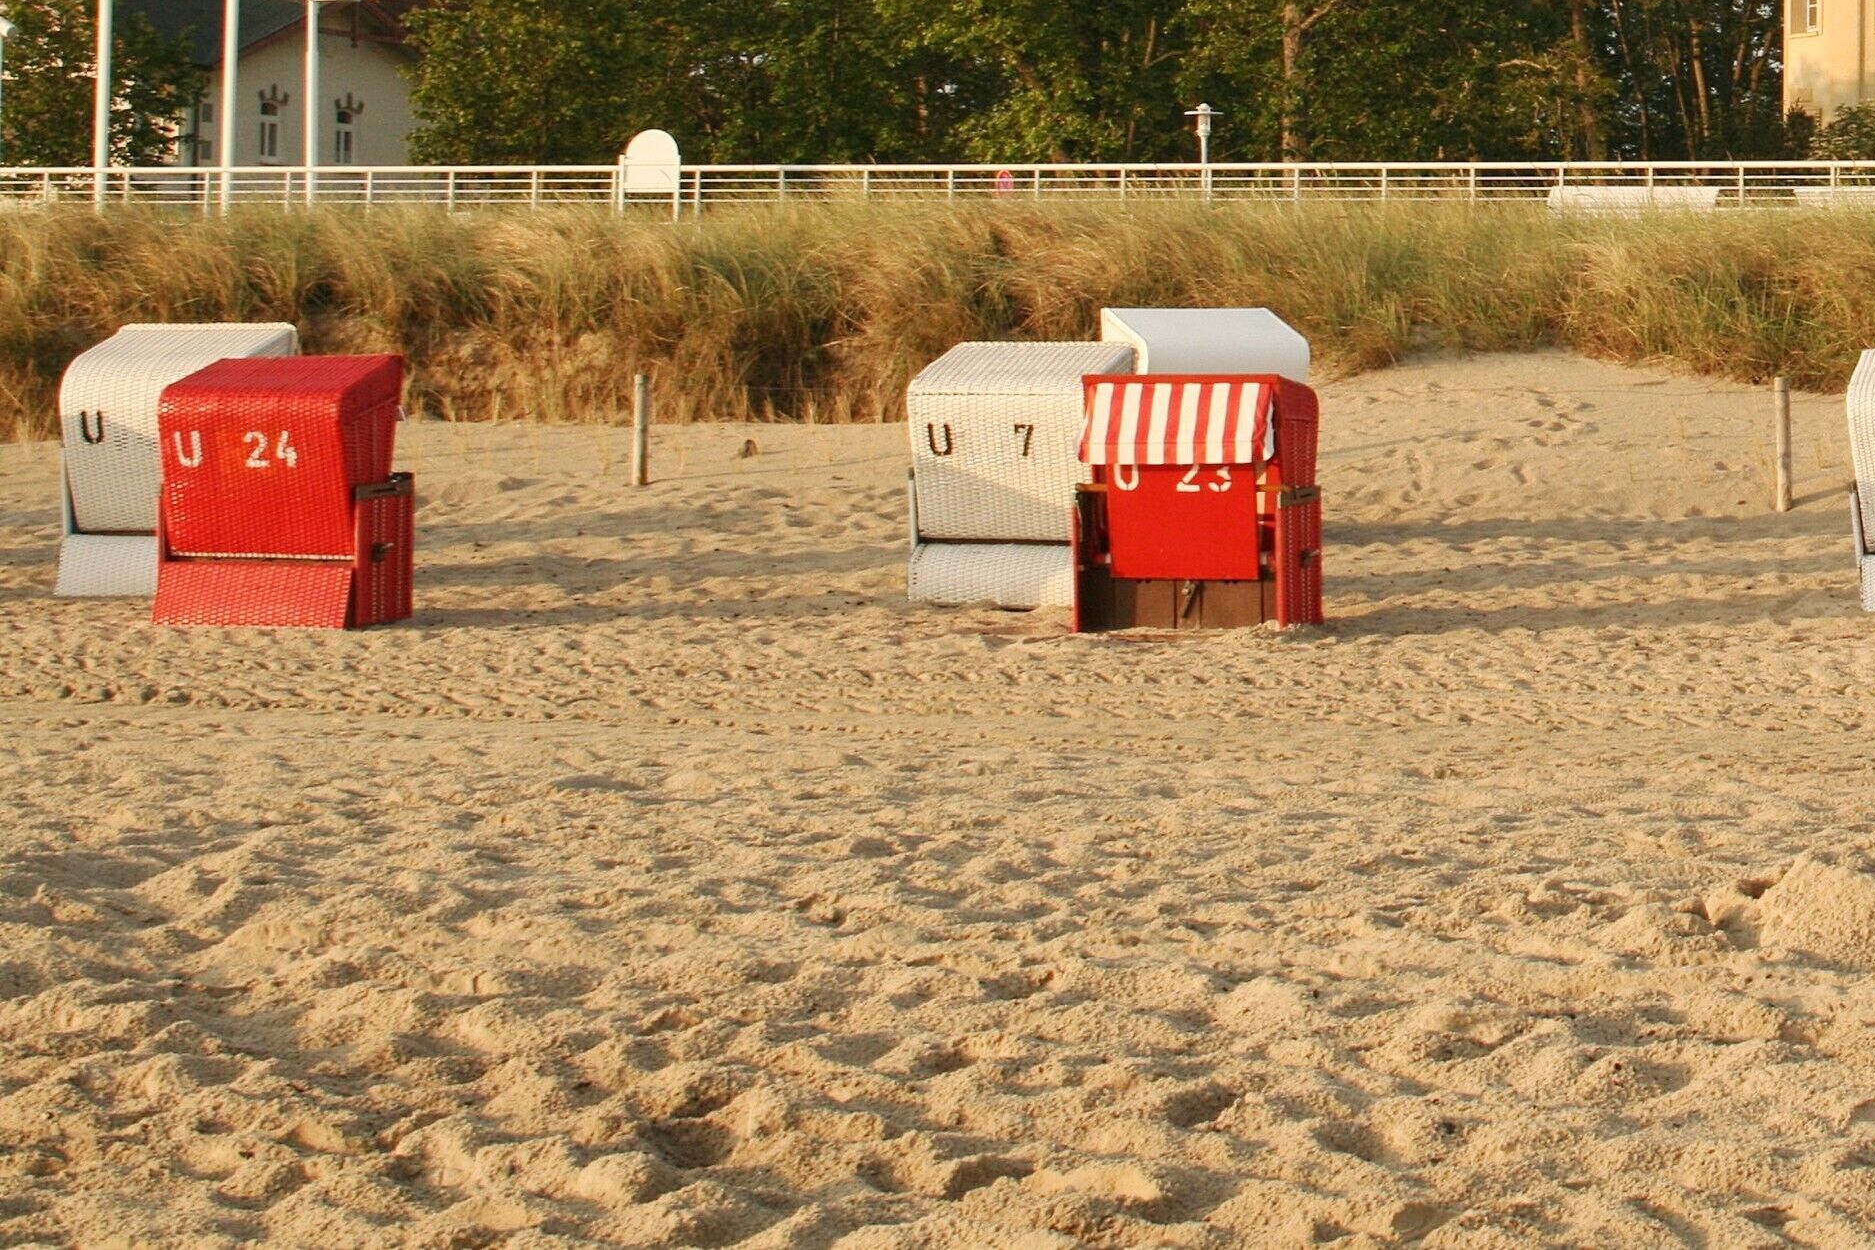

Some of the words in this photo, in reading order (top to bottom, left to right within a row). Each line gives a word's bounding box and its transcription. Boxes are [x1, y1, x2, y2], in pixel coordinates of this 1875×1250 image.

[80, 410, 104, 445] U
[927, 422, 953, 457] U
[1013, 423, 1035, 457] 7
[173, 429, 203, 469] U
[242, 429, 298, 469] 24
[1113, 462, 1140, 492] U
[1175, 463, 1233, 493] 23
